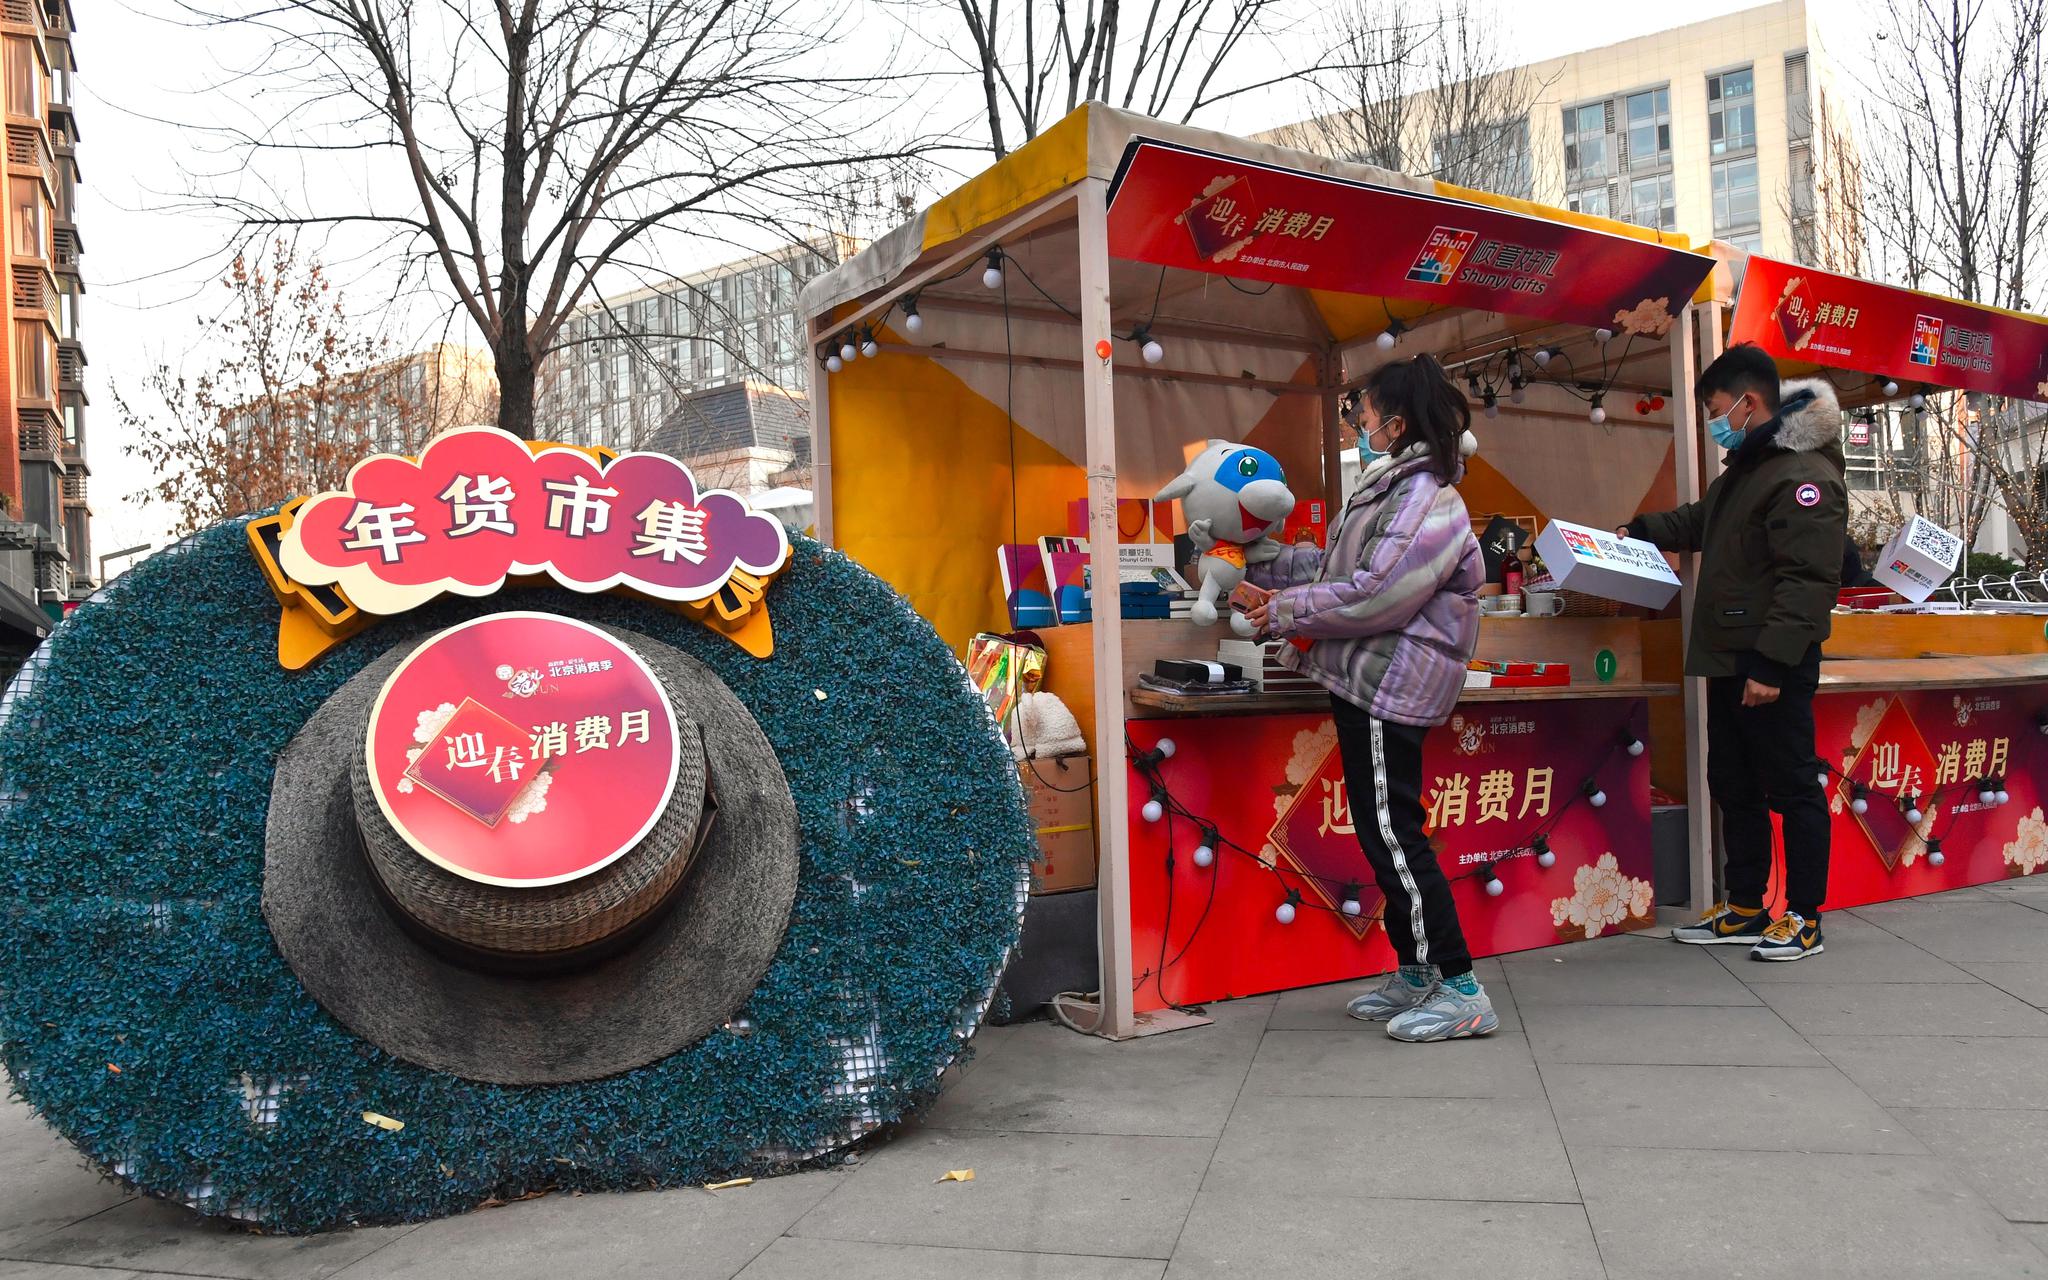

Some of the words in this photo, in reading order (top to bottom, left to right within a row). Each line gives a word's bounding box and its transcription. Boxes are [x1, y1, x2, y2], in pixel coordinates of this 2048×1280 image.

[1206, 196, 1247, 237] 迎春
[1254, 207, 1335, 240] 消费月
[1429, 233, 1468, 250] Shun
[1459, 268, 1511, 290] Shunyi
[1511, 276, 1547, 295] Gifts
[1787, 295, 1809, 329] 迎春
[1814, 301, 1860, 329] 消费月
[1917, 320, 1939, 335] Shun
[1941, 351, 1971, 371] Shunyi
[1971, 357, 1992, 373] Gifts
[343, 474, 708, 565] 年货市集
[1604, 552, 1643, 568] Shunyi
[1645, 561, 1672, 574] Gifts
[548, 659, 613, 678] 北京消费季
[1603, 657, 1610, 673] 1
[1490, 721, 1536, 735] 北京消费季
[445, 731, 525, 784] 迎春
[528, 709, 651, 760] 消费月
[1935, 737, 2010, 784] 消费月
[1318, 775, 1357, 838] 迎
[1428, 766, 1555, 829] 消费月
[1459, 852, 1488, 865] 主办单位
